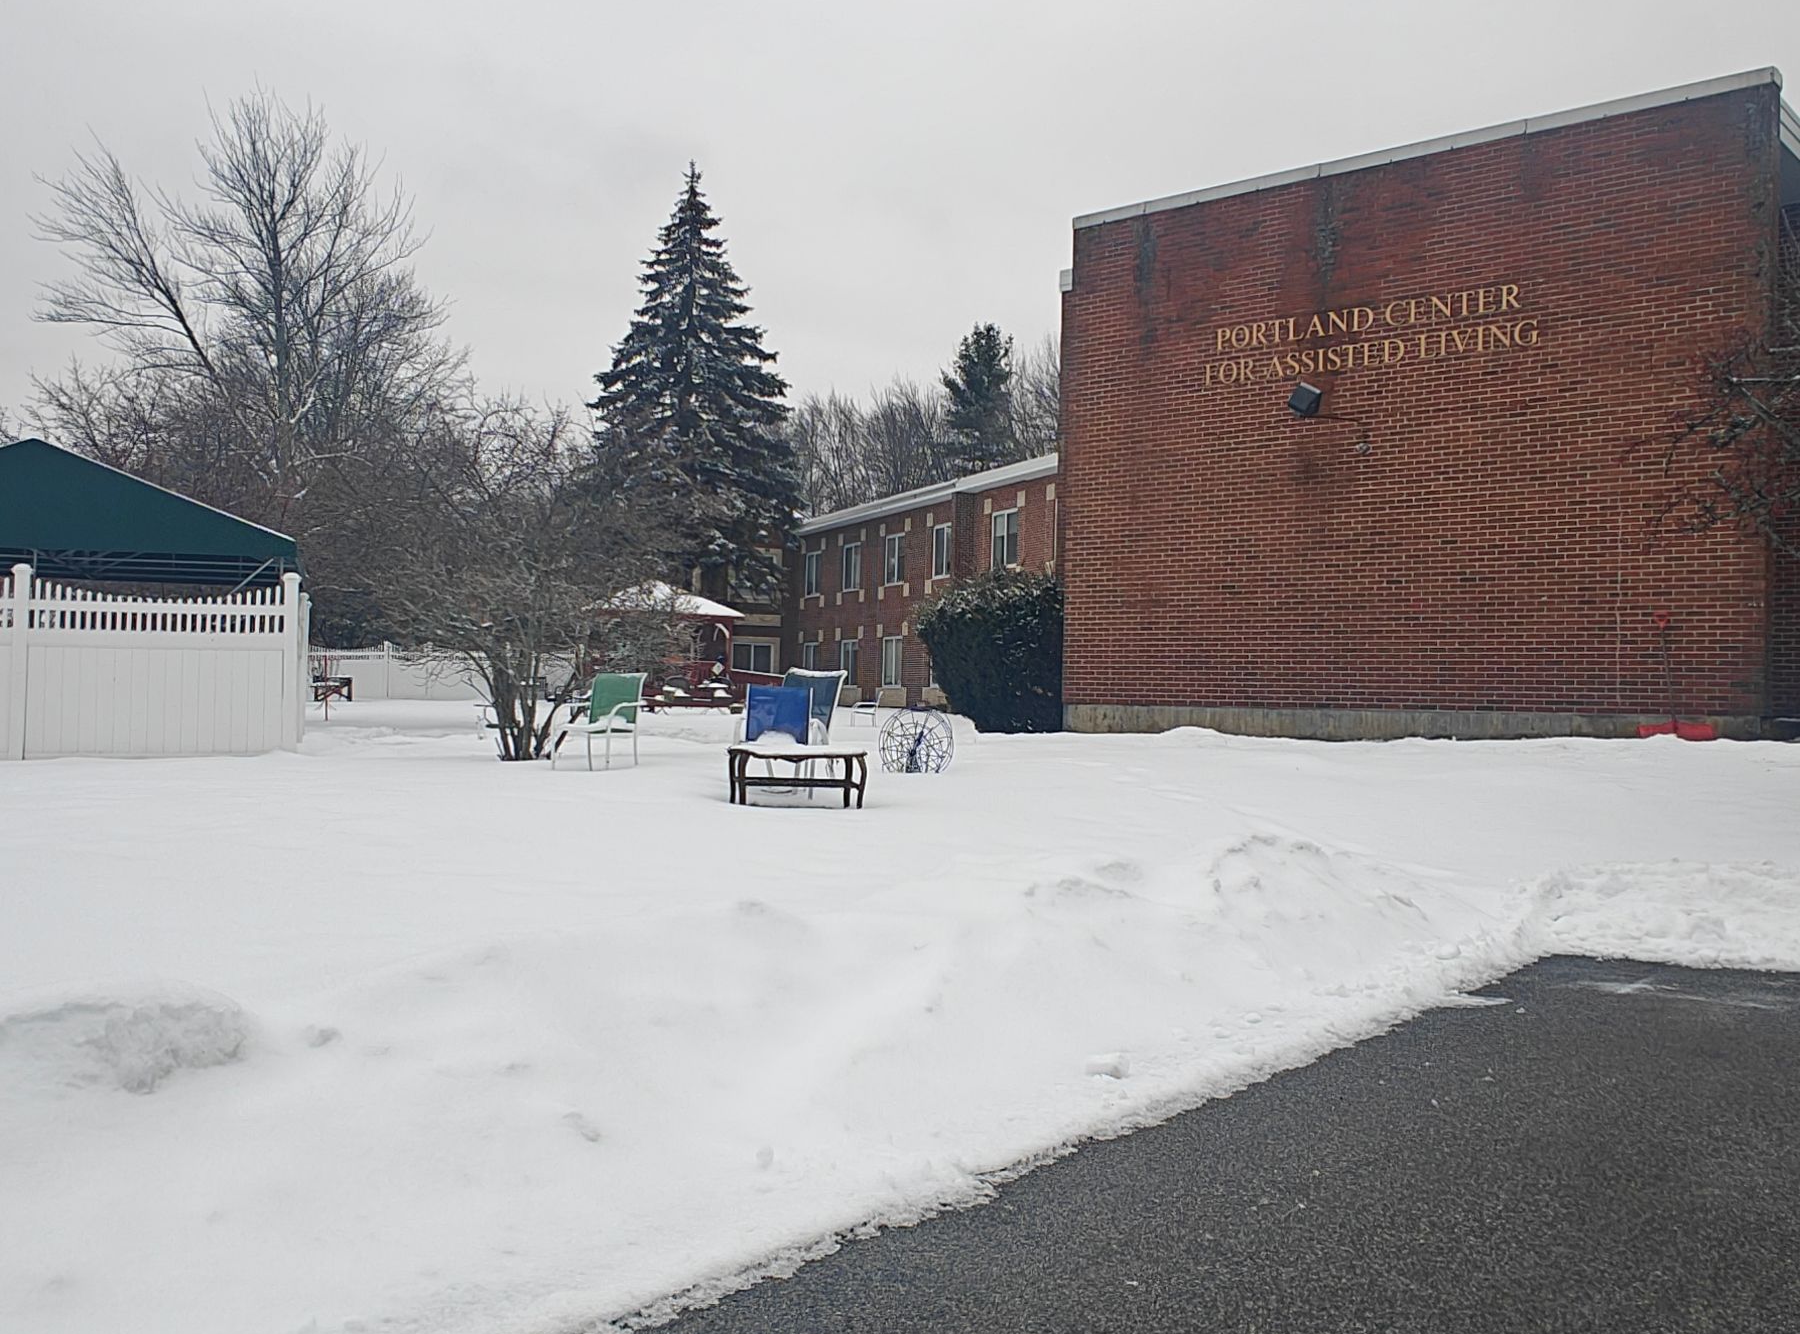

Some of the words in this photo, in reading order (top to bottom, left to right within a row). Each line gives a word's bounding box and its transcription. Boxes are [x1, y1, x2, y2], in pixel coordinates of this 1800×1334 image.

[1215, 305, 1375, 353] PORTLAND
[1385, 283, 1521, 327] CENTER
[1203, 359, 1255, 387] FOR
[1264, 338, 1405, 383] ASSISTED
[1416, 319, 1540, 360] LIVING
